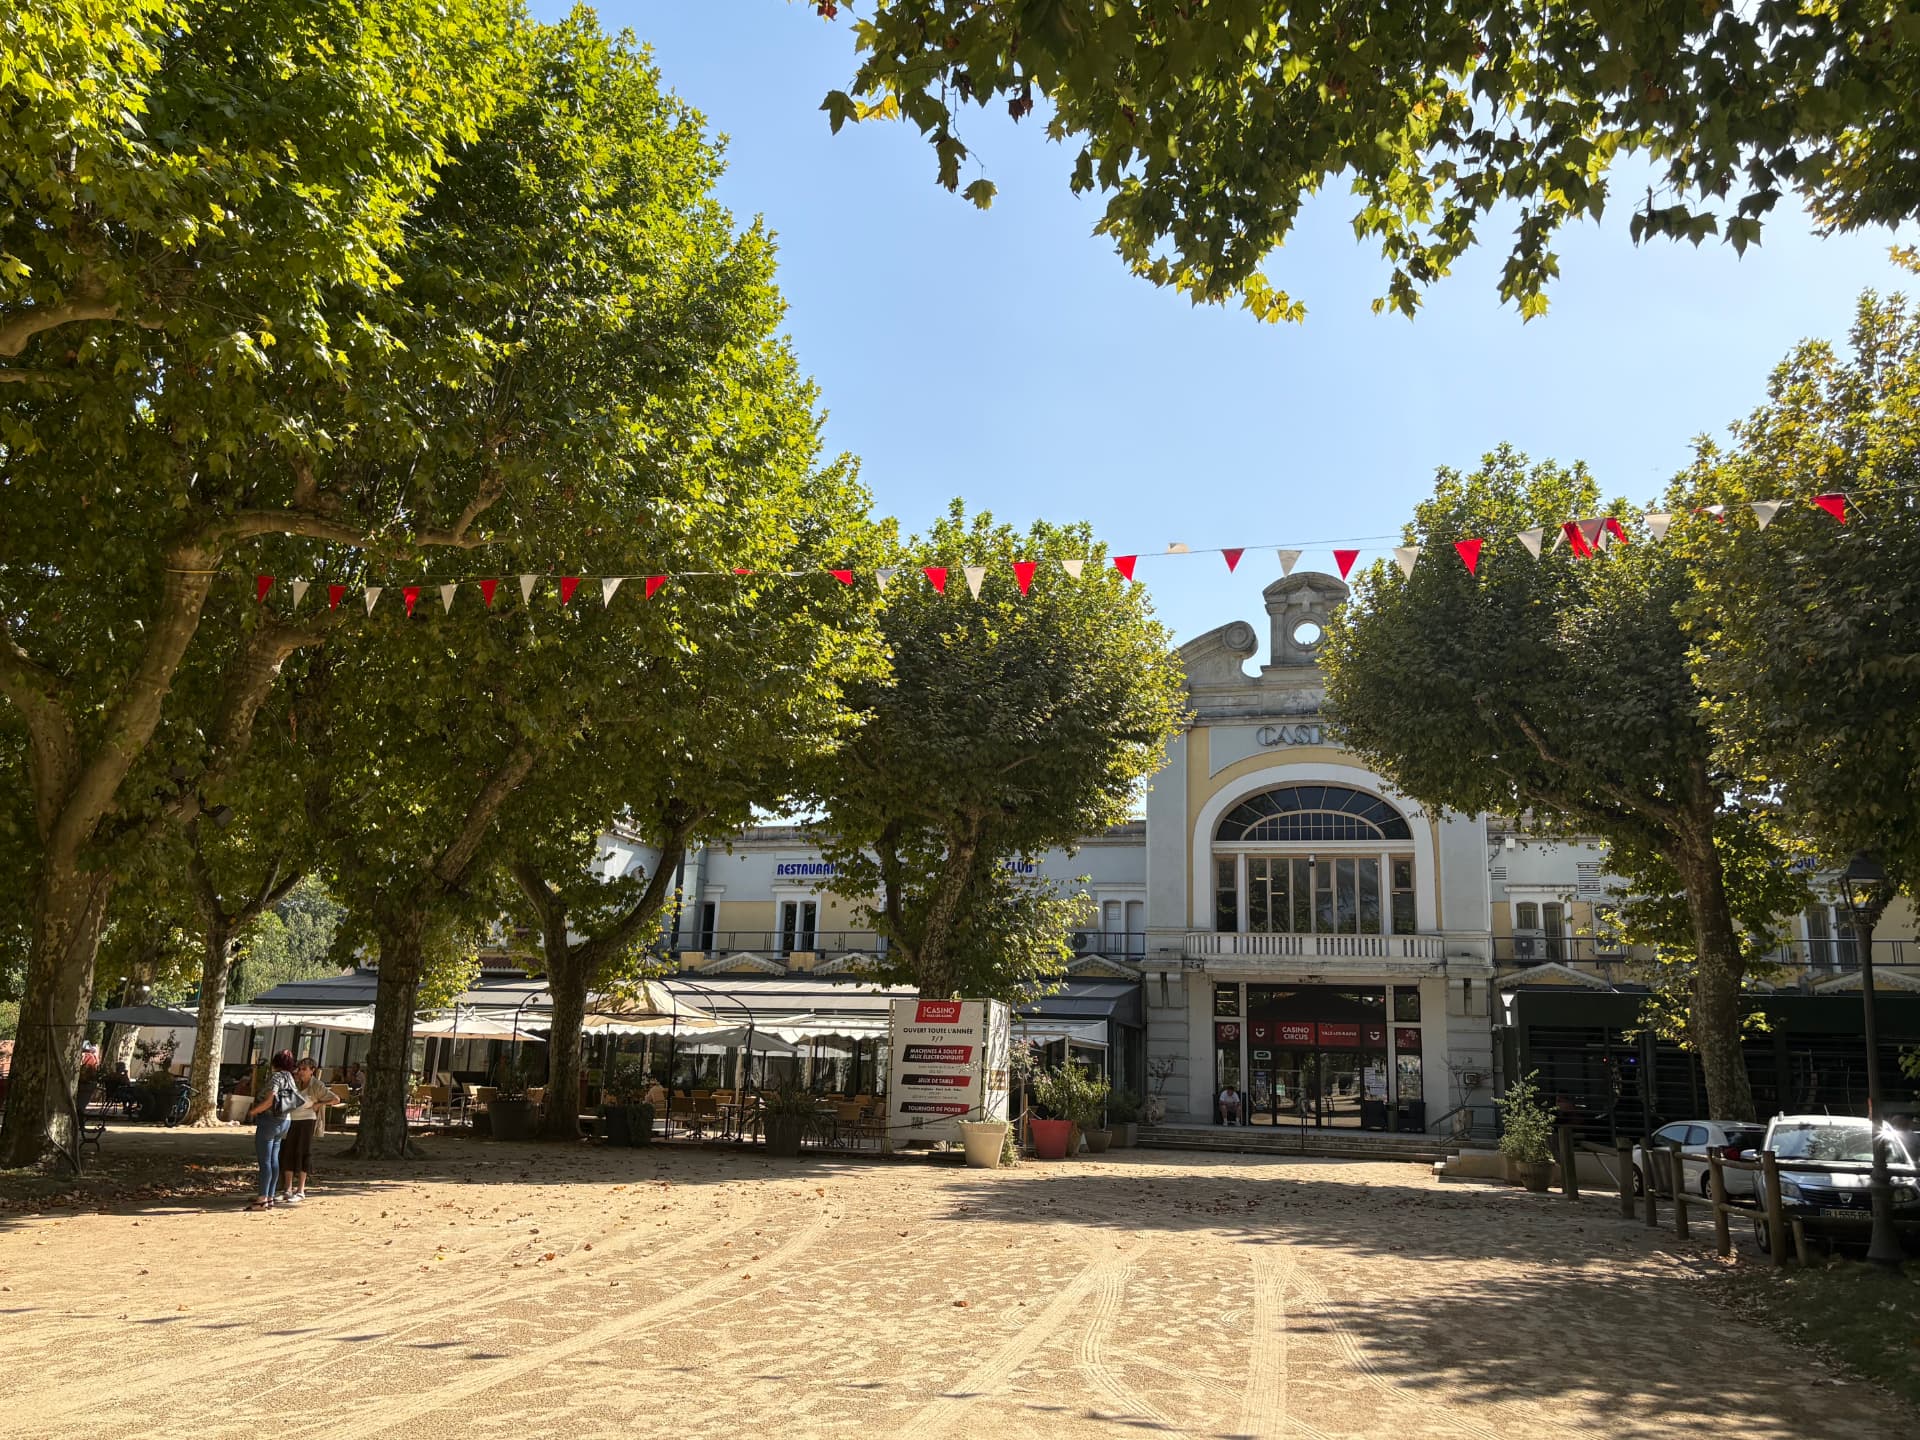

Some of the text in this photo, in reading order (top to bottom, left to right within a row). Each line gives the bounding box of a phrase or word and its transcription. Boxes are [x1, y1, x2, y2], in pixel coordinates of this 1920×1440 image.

[1256, 725, 1327, 746] CASI
[777, 863, 842, 875] RESTAURAN
[926, 1006, 955, 1014] CASINO
[948, 1026, 974, 1035] L'ANNÉE
